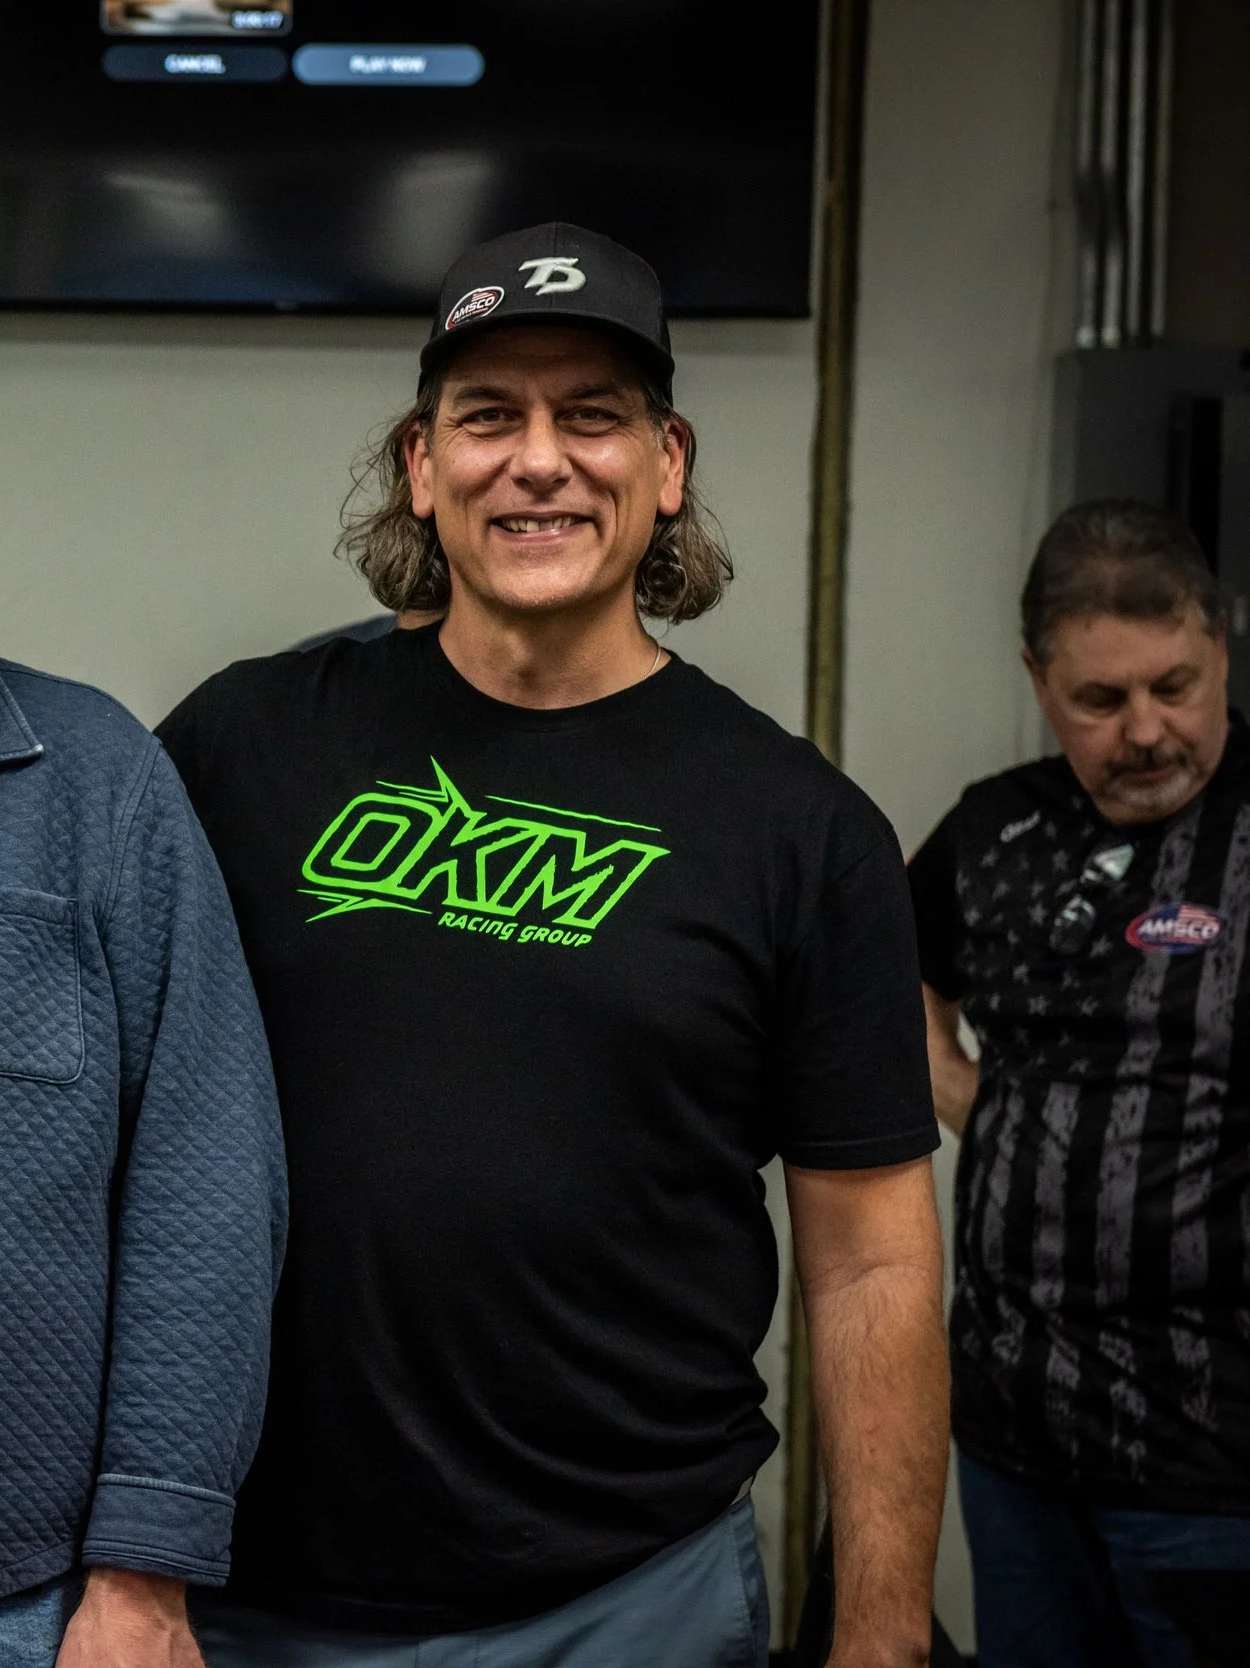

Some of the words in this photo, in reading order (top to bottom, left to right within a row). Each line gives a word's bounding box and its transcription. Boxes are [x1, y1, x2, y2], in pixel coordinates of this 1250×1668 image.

[452, 295, 496, 322] AMSCO
[302, 785, 671, 930] OKM
[438, 911, 518, 941] RACING
[517, 924, 594, 948] GROUP
[1138, 918, 1221, 941] AMSCO
